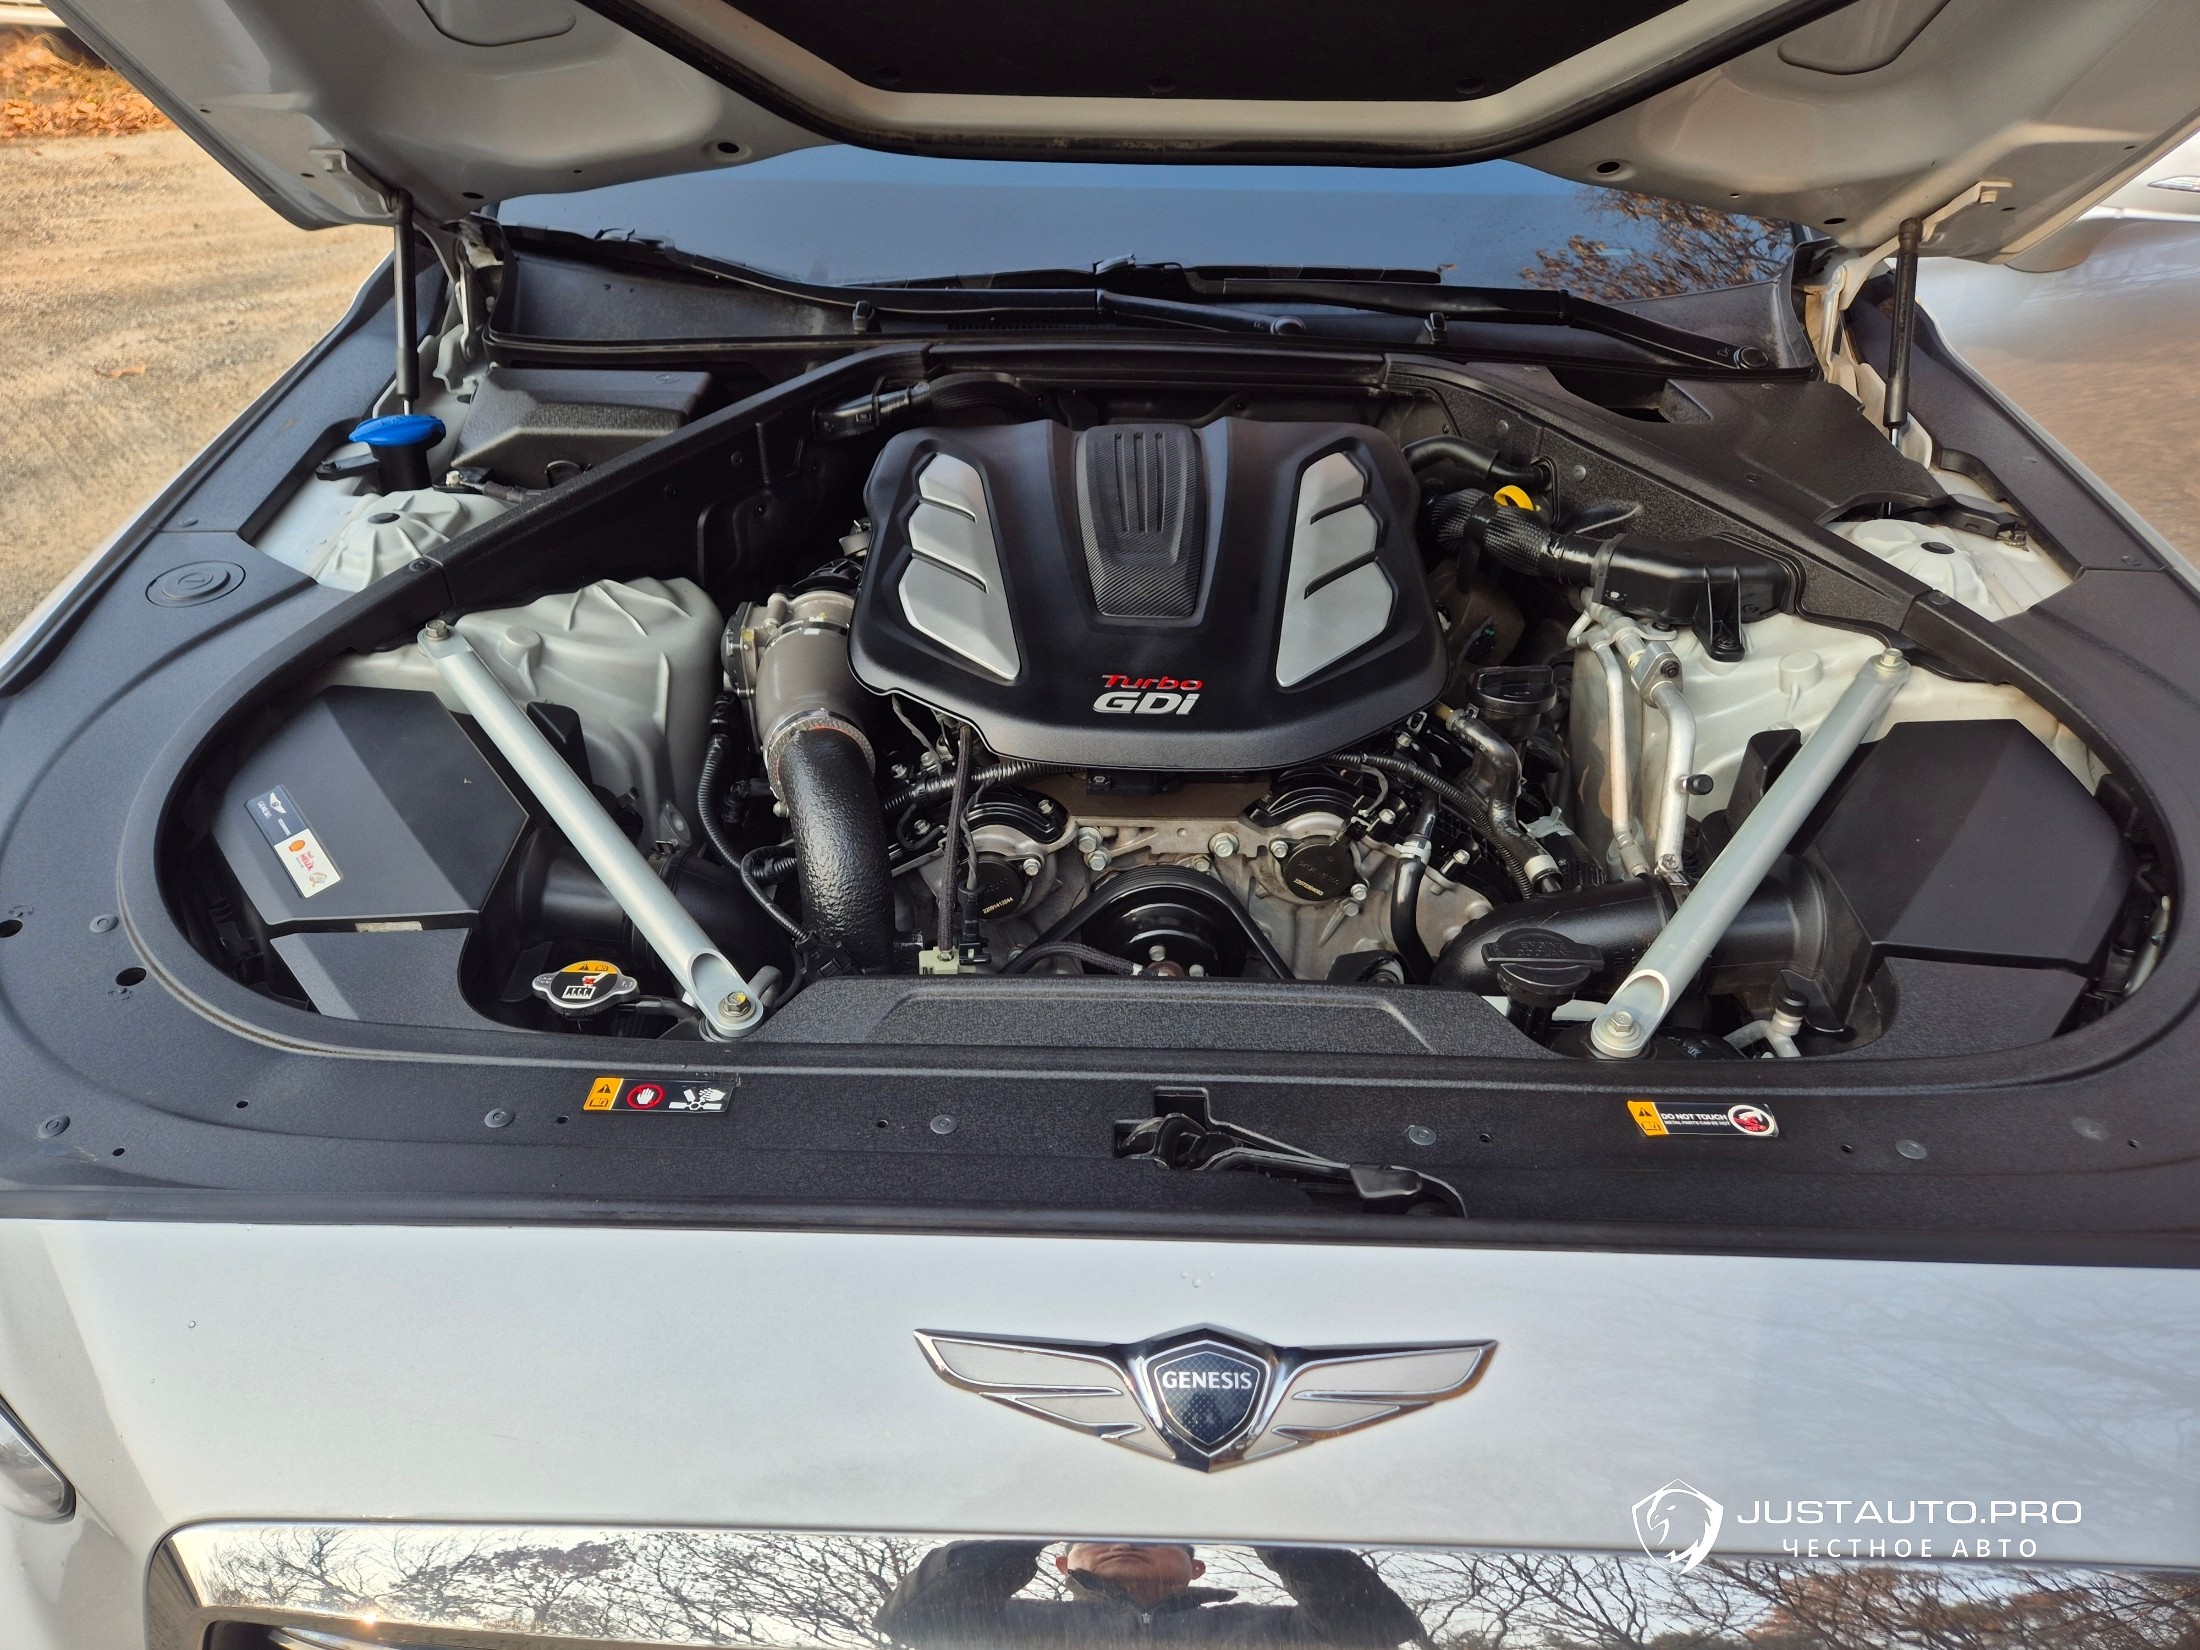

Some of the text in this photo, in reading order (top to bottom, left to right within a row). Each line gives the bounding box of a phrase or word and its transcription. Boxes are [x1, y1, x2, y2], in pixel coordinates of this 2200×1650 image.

[1102, 674, 1204, 691] Turbo
[1093, 691, 1200, 715] GDi
[1694, 1113, 1728, 1121] TOUCH
[1162, 1371, 1252, 1389] GENESIS
